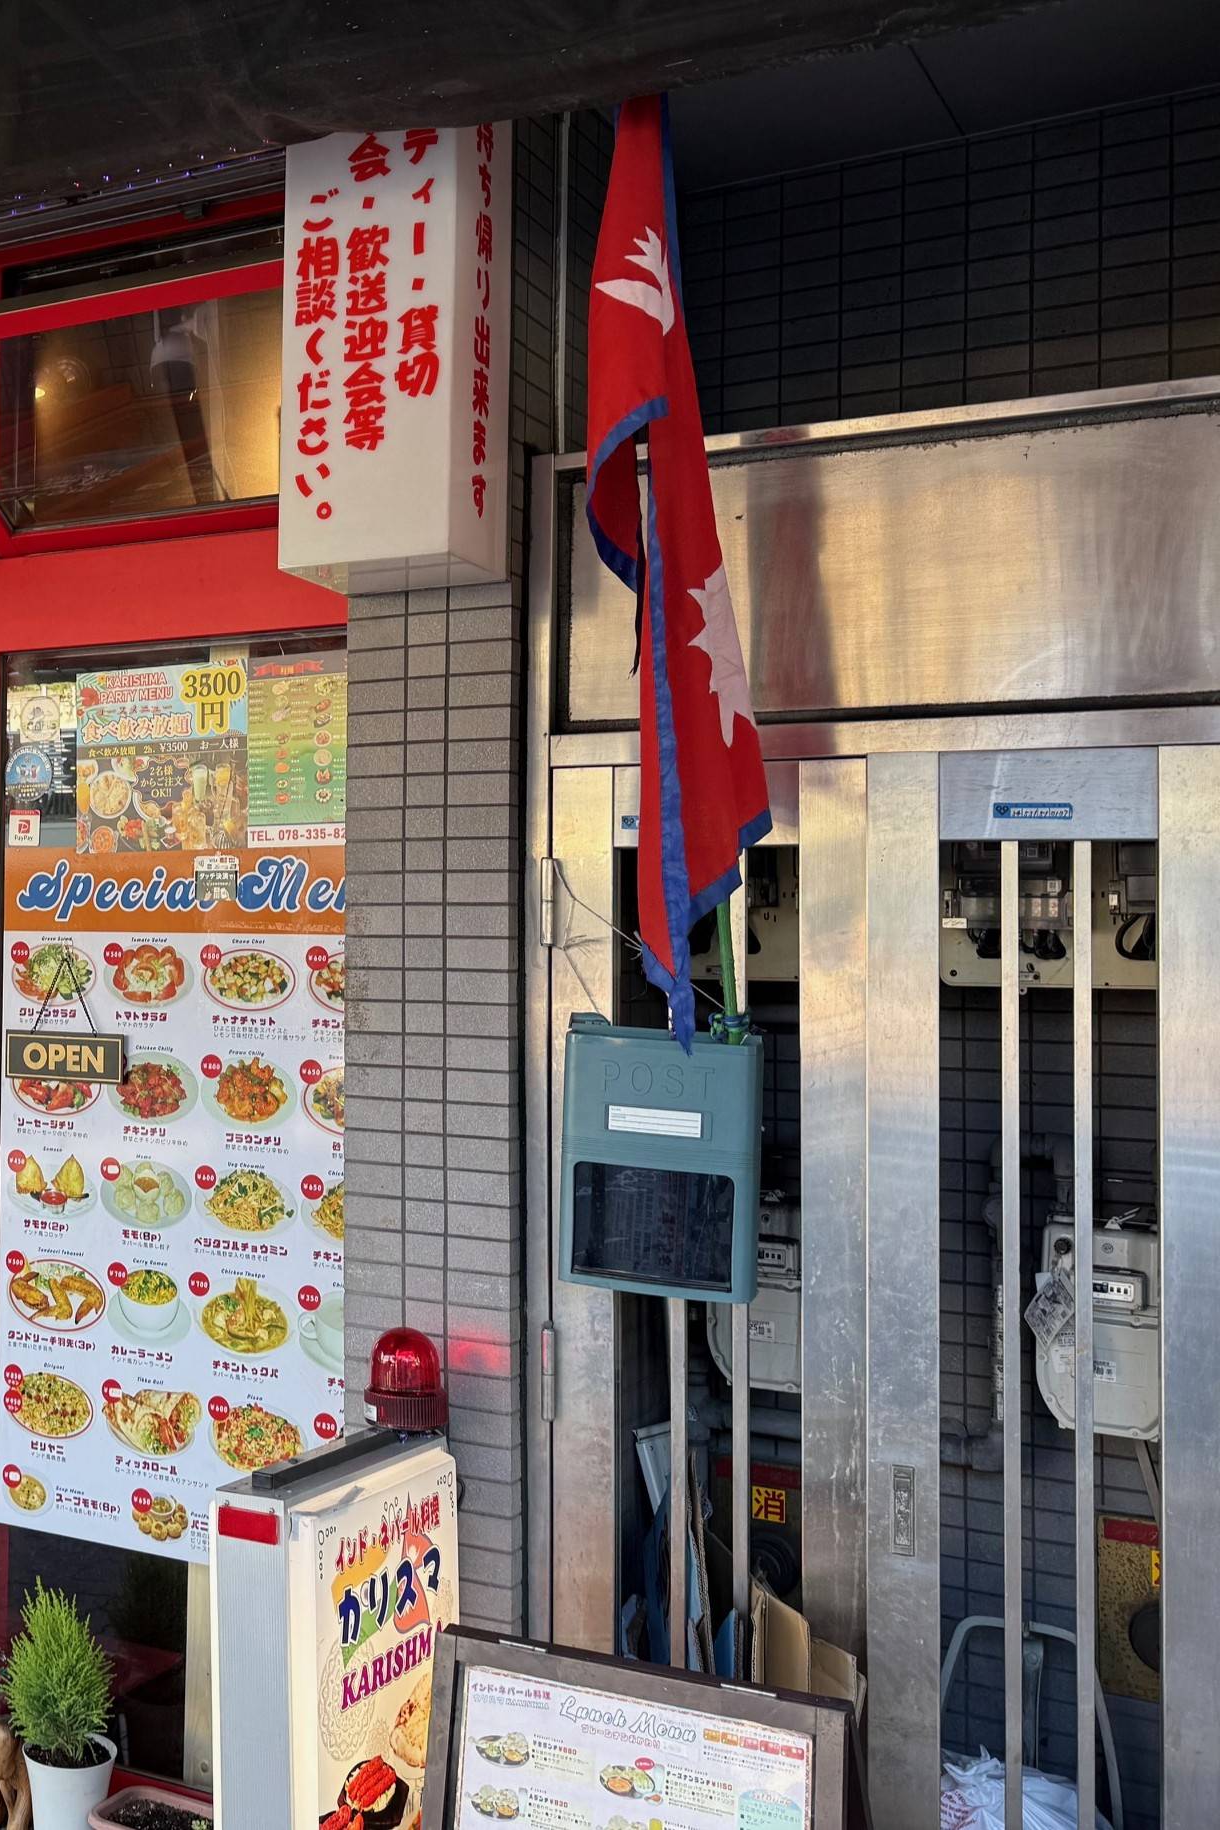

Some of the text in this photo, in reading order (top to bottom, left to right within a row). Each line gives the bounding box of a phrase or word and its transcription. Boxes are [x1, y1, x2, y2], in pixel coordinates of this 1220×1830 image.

[294, 187, 339, 520] ご相談ください。
[100, 686, 173, 704] PARTY MENU
[106, 672, 167, 688] KARISHMA
[201, 701, 224, 729] 円
[250, 830, 275, 842] TEL.
[312, 1018, 344, 1029] チキン
[23, 1042, 105, 1073] OPEN
[600, 1058, 716, 1100] POST
[754, 1488, 784, 1521] 消
[337, 1544, 441, 1646] カリスマ
[340, 1617, 442, 1713] KARISHM
